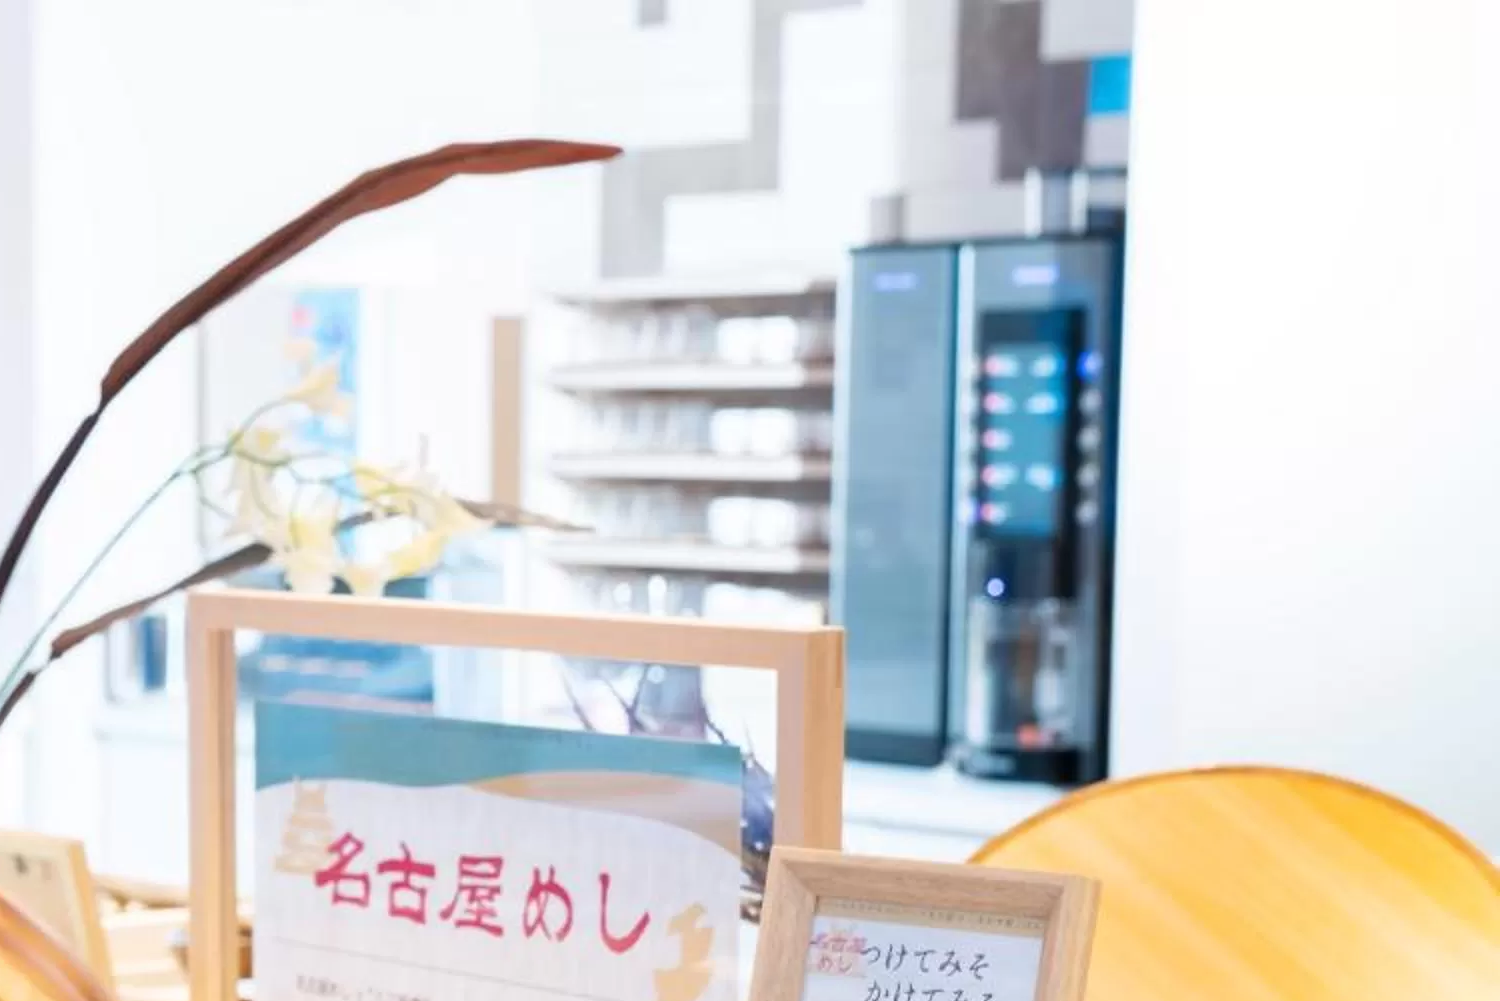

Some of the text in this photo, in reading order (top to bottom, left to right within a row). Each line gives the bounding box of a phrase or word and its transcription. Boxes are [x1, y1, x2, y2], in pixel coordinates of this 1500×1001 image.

[314, 832, 651, 954] 名古屋めし
[861, 943, 990, 980] つけてみそ
